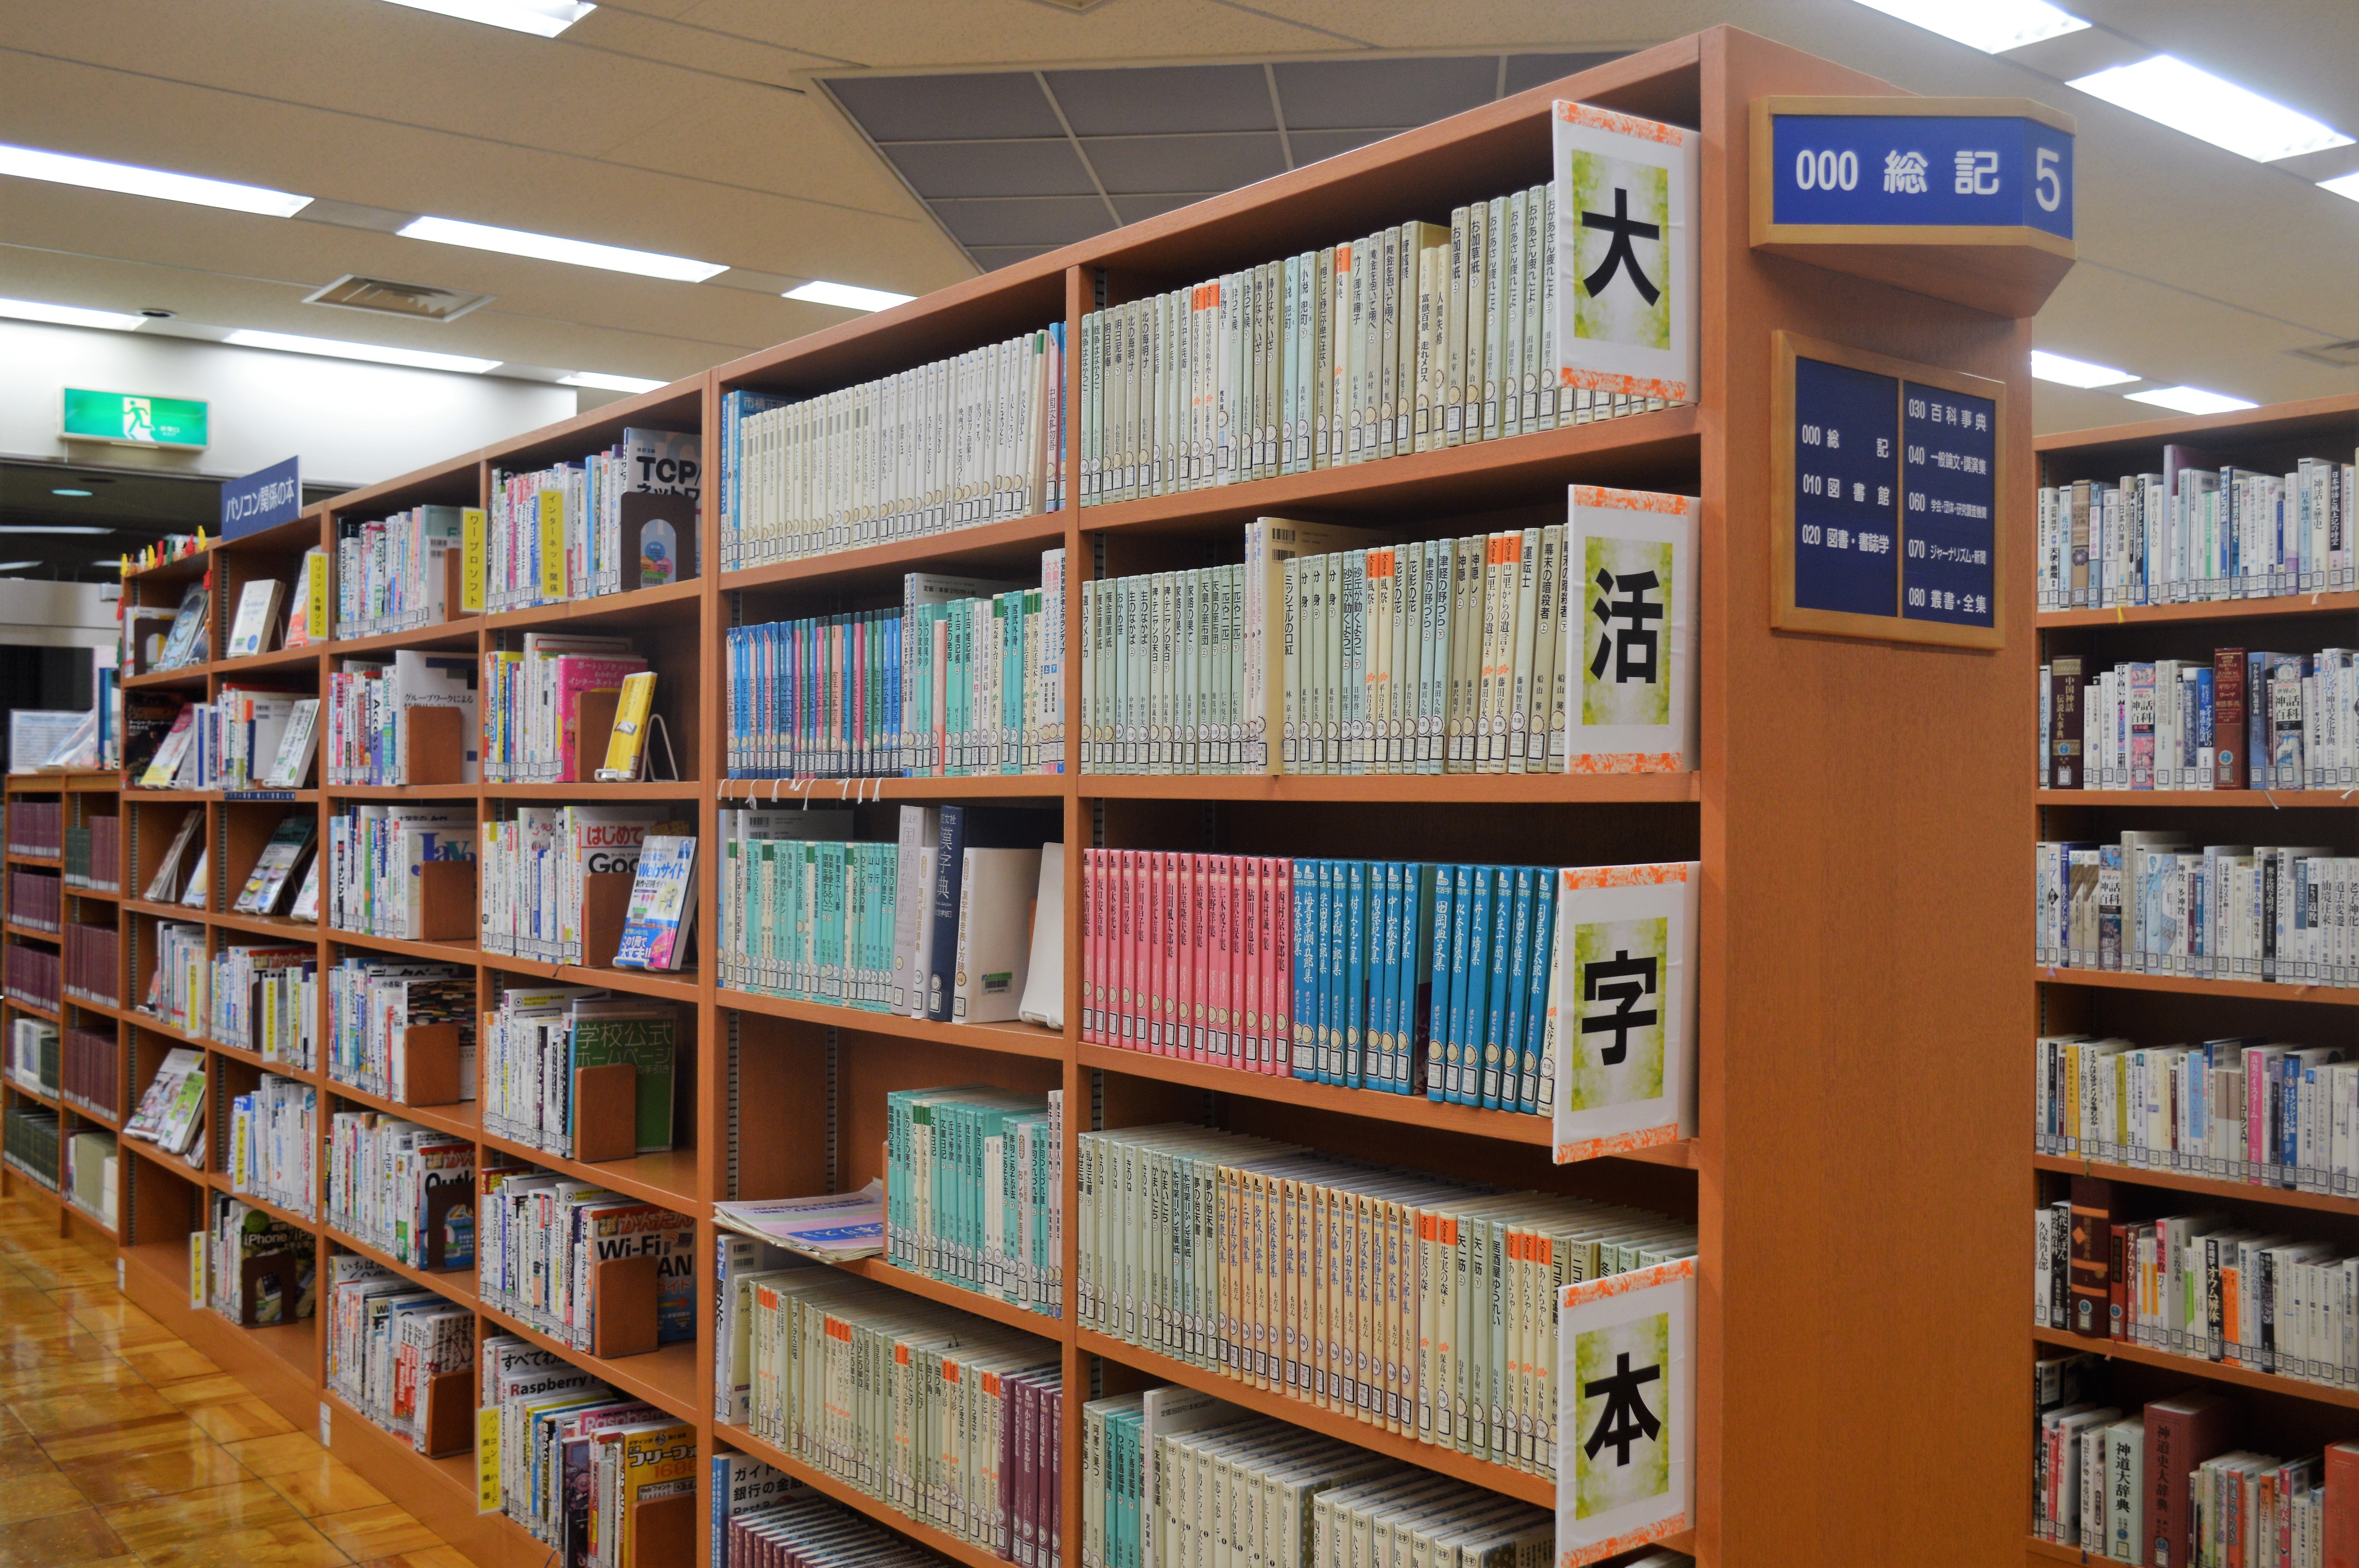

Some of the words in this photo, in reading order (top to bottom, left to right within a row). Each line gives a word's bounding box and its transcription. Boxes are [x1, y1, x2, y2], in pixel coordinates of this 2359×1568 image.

[1796, 150, 1859, 191] 000
[2034, 147, 2061, 212] 5
[1581, 187, 1660, 307] 大
[1909, 399, 1925, 419] 030
[1932, 404, 1986, 432] 百科事典
[1803, 425, 1820, 445] 000
[1909, 445, 1925, 465] 040
[1803, 474, 1821, 495] 010
[226, 477, 294, 523] パソコン関係の本
[1909, 492, 1925, 512] 060
[549, 495, 558, 592] インターネット関係
[1803, 524, 1820, 545] 020
[1827, 528, 1889, 554] 図書・書誌学
[1909, 539, 1925, 558] 070
[1930, 545, 1986, 564] ジャーナリズム・新聞
[470, 515, 479, 606] ワープロソフト
[1909, 588, 1925, 606] 080
[1931, 590, 1986, 613] 叢書・全集
[1590, 567, 1663, 685] 活
[587, 826, 644, 846] はじめて
[638, 863, 684, 879] Webサイト
[957, 891, 968, 972] 漢字書き表し方辞
[1581, 949, 1658, 1067] 字
[576, 1022, 671, 1049] 学校公式
[597, 1235, 661, 1260] Wi-Fi
[511, 1376, 587, 1396] Raspberry
[1583, 1351, 1661, 1468] 本
